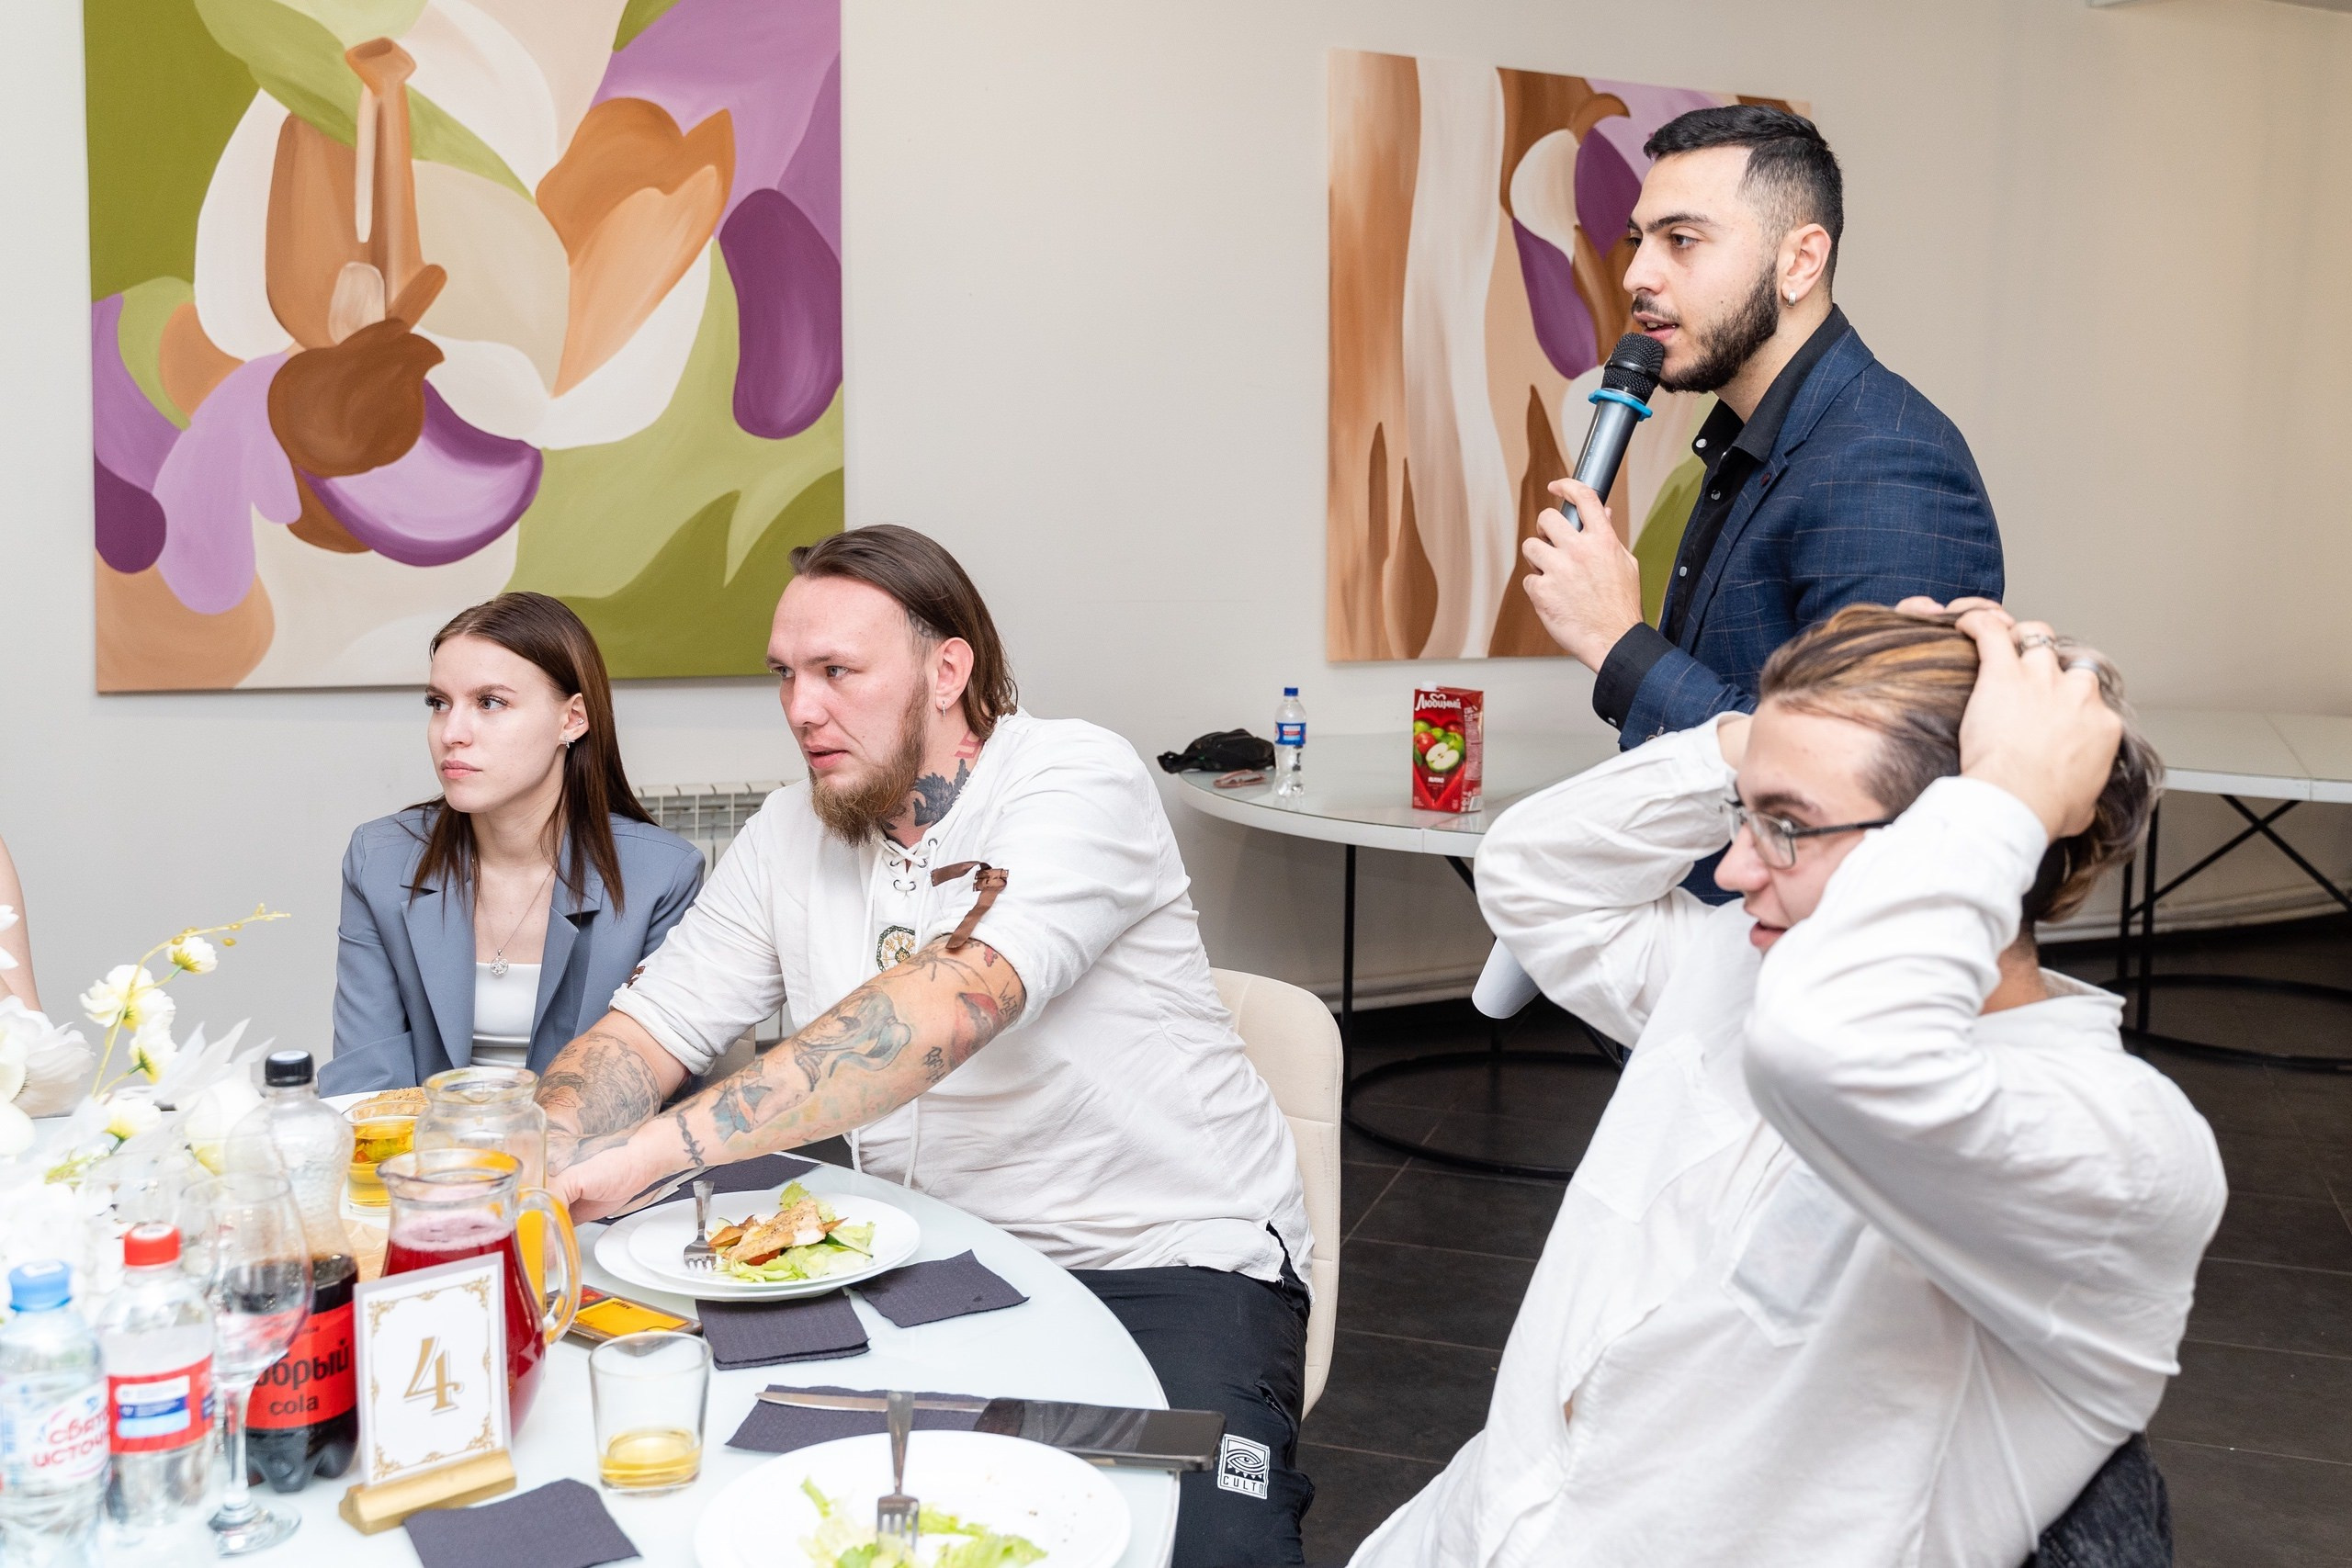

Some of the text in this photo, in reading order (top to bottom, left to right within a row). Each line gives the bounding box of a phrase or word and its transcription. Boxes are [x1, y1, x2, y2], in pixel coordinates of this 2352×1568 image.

[256, 1338, 350, 1391] обрый
[403, 1336, 465, 1416] 4
[269, 1393, 319, 1416] cola
